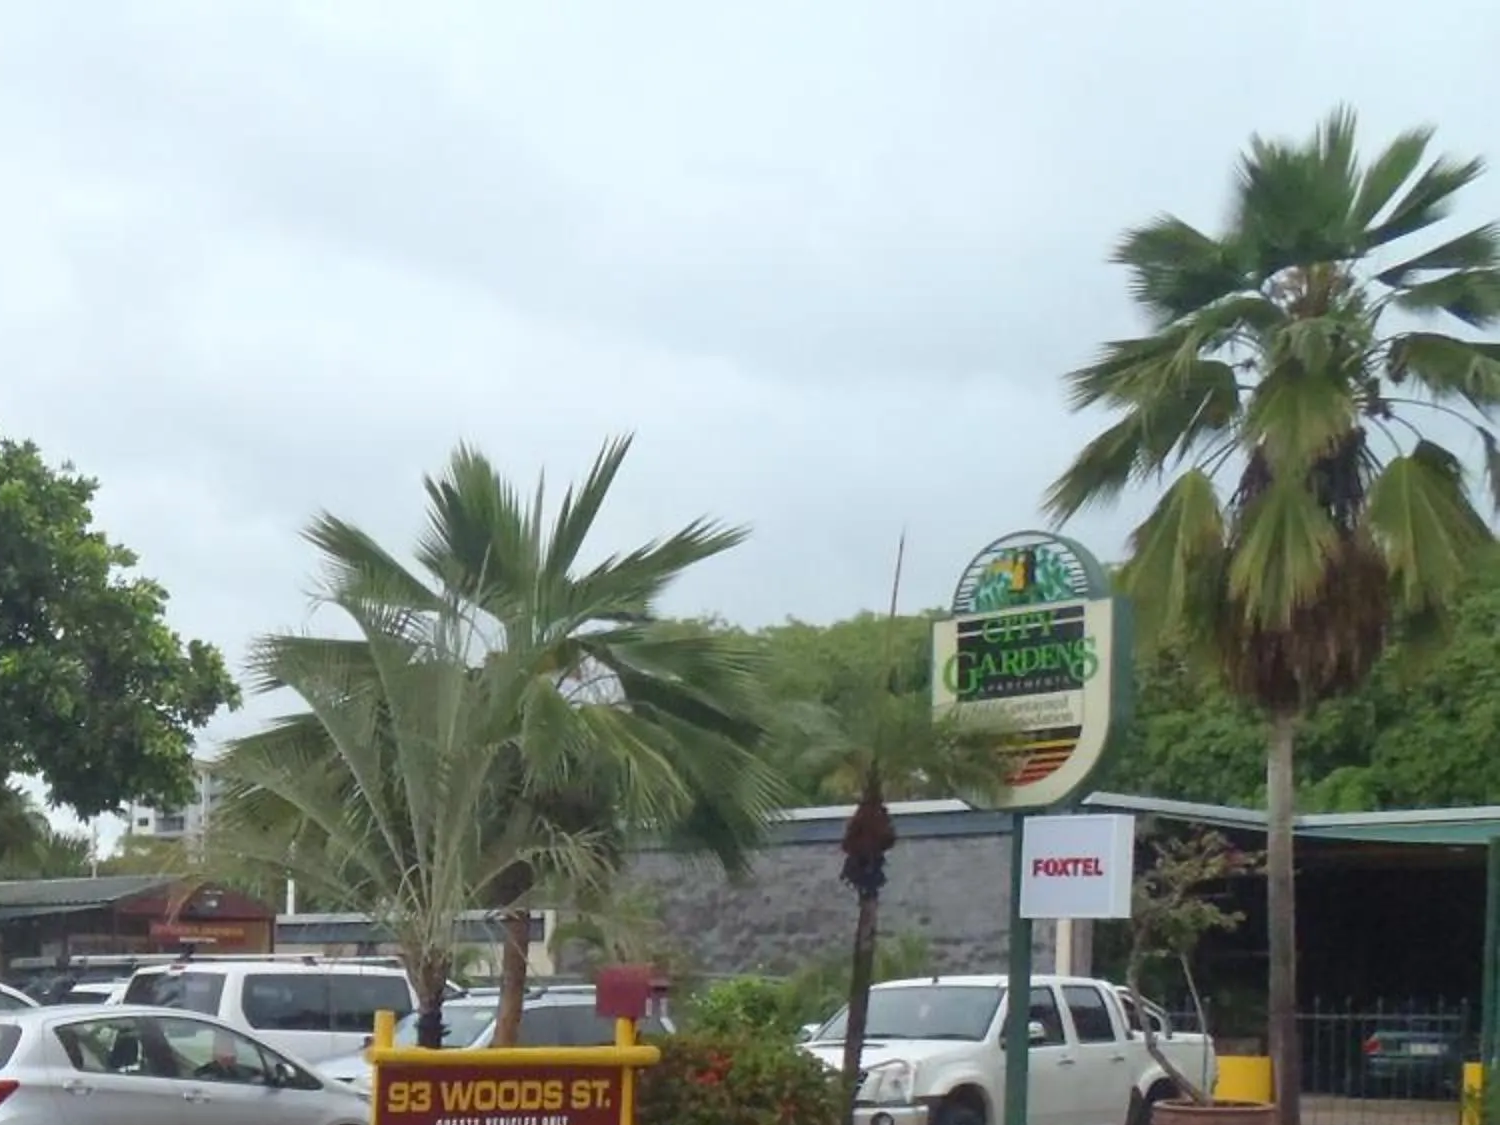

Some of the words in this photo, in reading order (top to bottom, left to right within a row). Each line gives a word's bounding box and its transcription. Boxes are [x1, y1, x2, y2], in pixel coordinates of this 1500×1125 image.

[982, 610, 1057, 643] CITY
[943, 636, 1099, 695] GARDENS
[1032, 857, 1104, 877] FOXTEL
[387, 1081, 432, 1113] 93
[441, 1079, 564, 1112] WOODS
[570, 1078, 611, 1110] ST.
